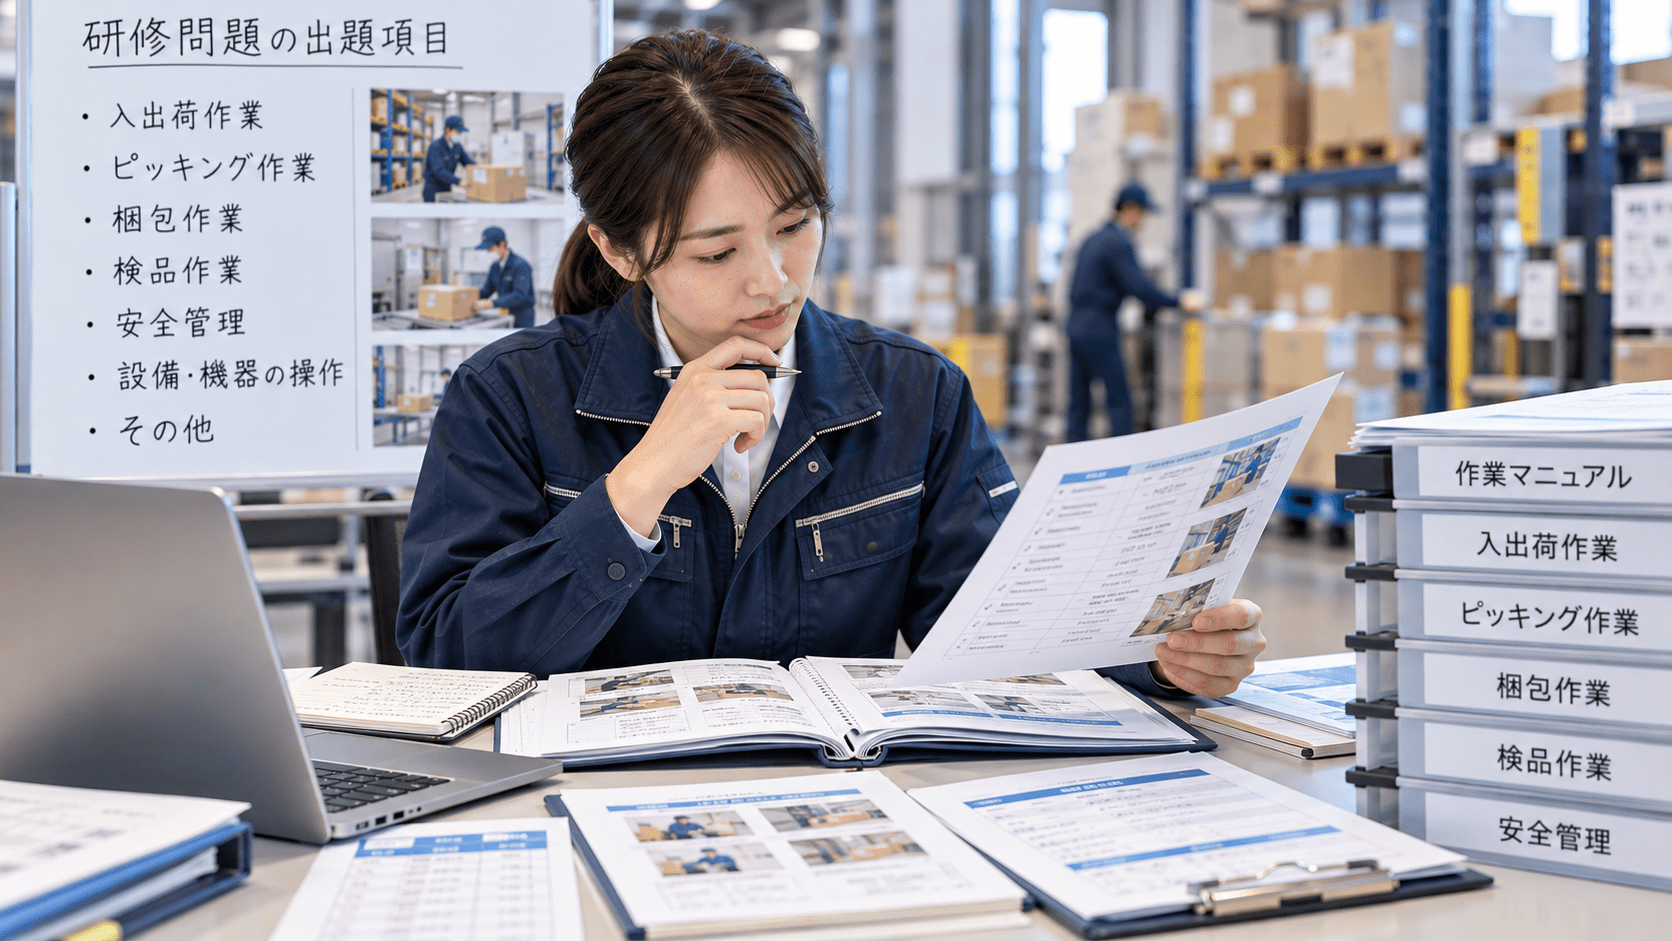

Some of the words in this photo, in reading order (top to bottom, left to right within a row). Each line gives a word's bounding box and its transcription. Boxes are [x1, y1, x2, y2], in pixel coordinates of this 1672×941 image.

[82, 17, 447, 58] 研修問題の出題項目
[110, 99, 263, 131] 入出荷作業
[114, 152, 315, 183] ピッキング作業
[112, 203, 243, 234] 梱包作業
[113, 254, 242, 286] 検品作業
[116, 306, 245, 339] 安全管理
[119, 414, 214, 446] その他
[1455, 460, 1633, 489] 作業マニュアル
[1477, 531, 1618, 562] 入出荷作業
[1461, 600, 1640, 636] ピッキング作業
[1496, 672, 1610, 707] 梱包作業
[1497, 743, 1612, 782] 検品作業
[1499, 815, 1612, 856] 安全管理
